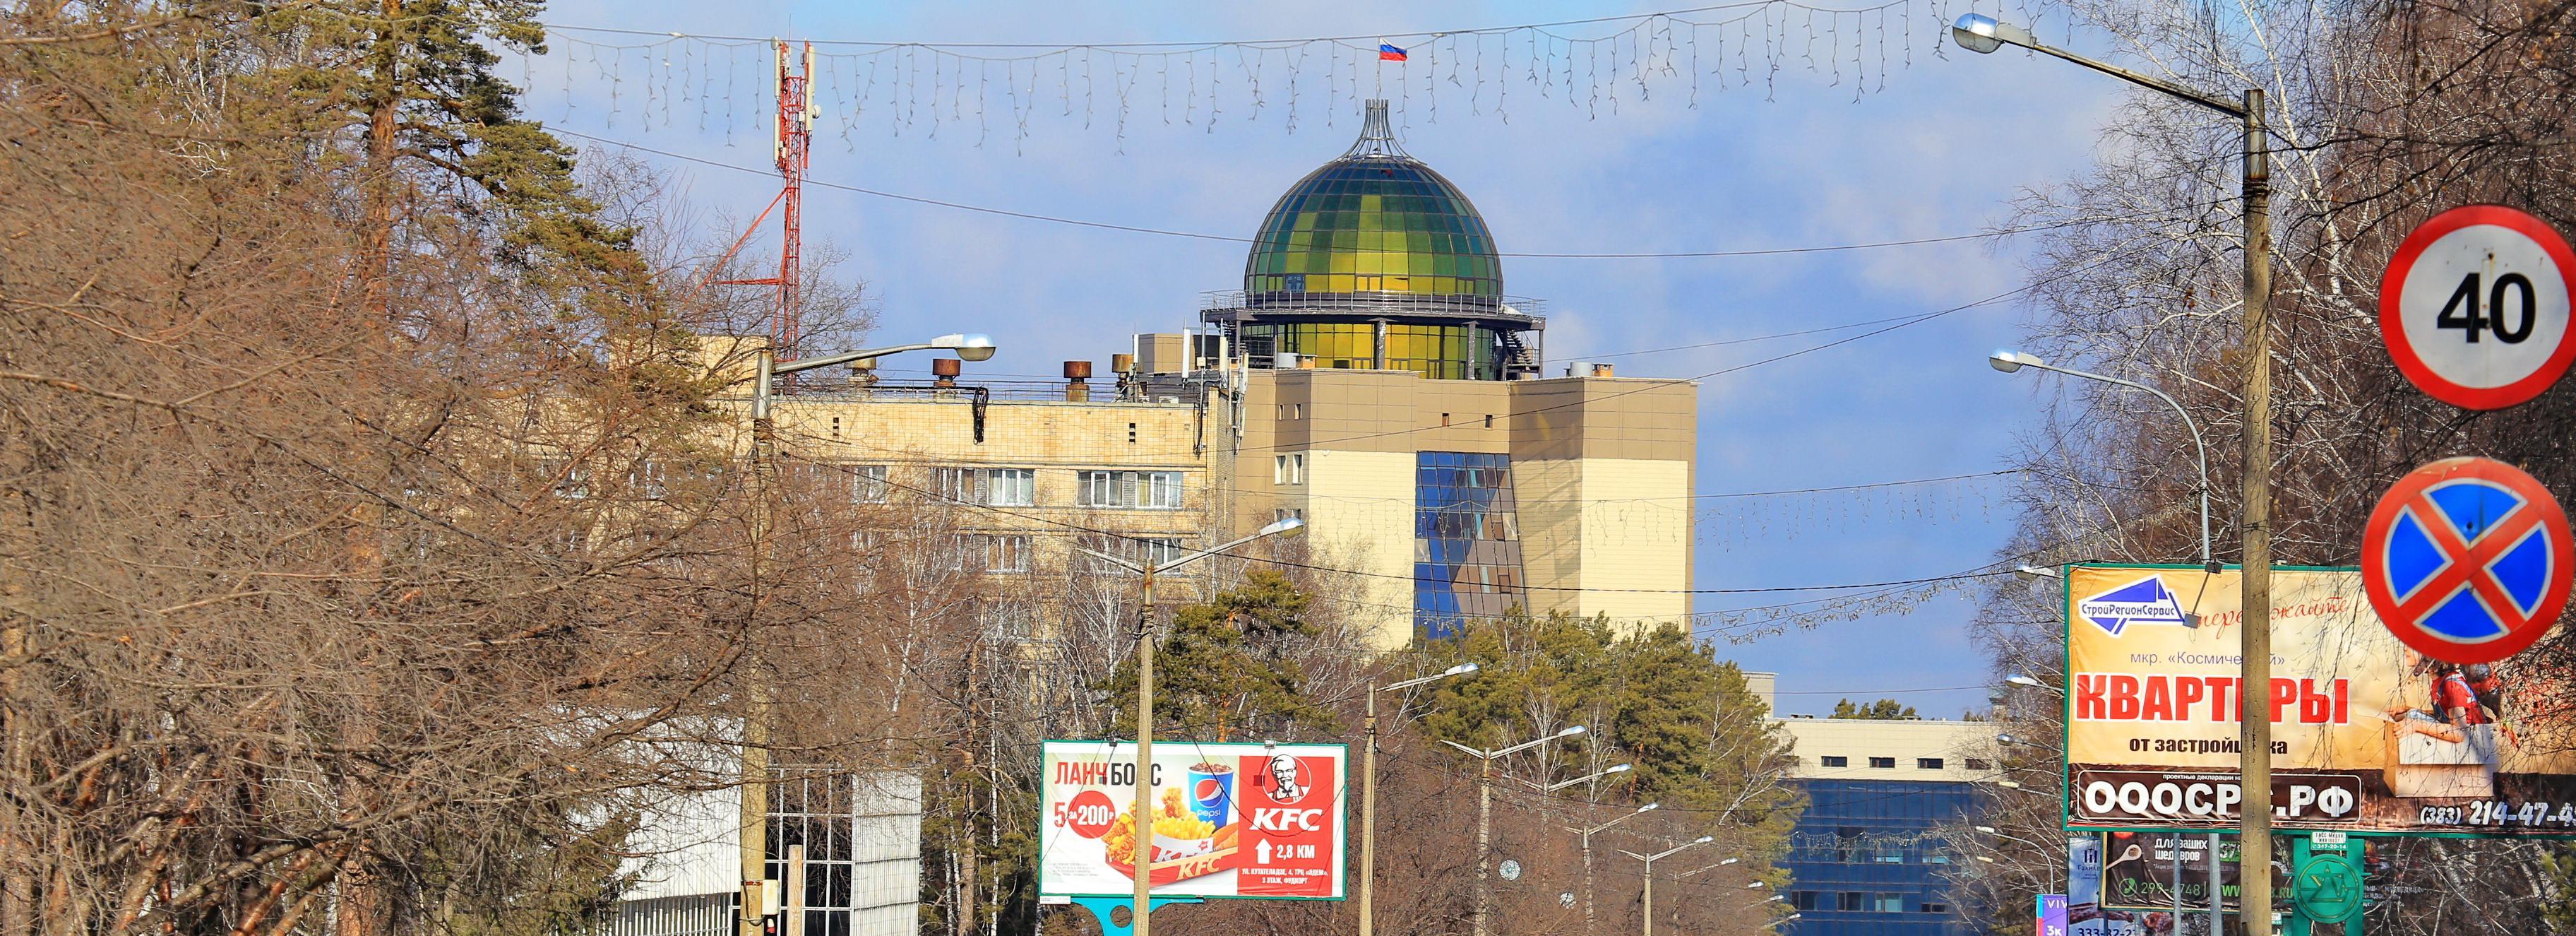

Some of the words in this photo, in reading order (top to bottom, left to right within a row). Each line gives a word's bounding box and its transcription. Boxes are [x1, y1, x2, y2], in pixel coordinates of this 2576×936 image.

[2437, 273, 2536, 344] 40
[2082, 603, 2175, 617] СтройРегионСервис
[2198, 597, 2348, 639] пережайте
[2130, 653, 2162, 665] мкр.
[2076, 675, 2349, 724] КВАРТРЫ
[2130, 737, 2148, 752] от
[2155, 736, 2288, 754] застройка
[1054, 762, 1162, 786] ЛАНЧБОС
[2085, 780, 2354, 817] ОООСР.РФ
[1054, 802, 1066, 828] 5
[1197, 809, 1221, 819] pepsi
[1248, 807, 1323, 831] KFC
[2420, 806, 2462, 826] (383)
[2469, 800, 2576, 827] 214-47-4
[1276, 844, 1294, 860] 2,8
[1296, 844, 1315, 859] КМ
[2155, 850, 2200, 863] шедвров
[1176, 857, 1222, 881] KFC
